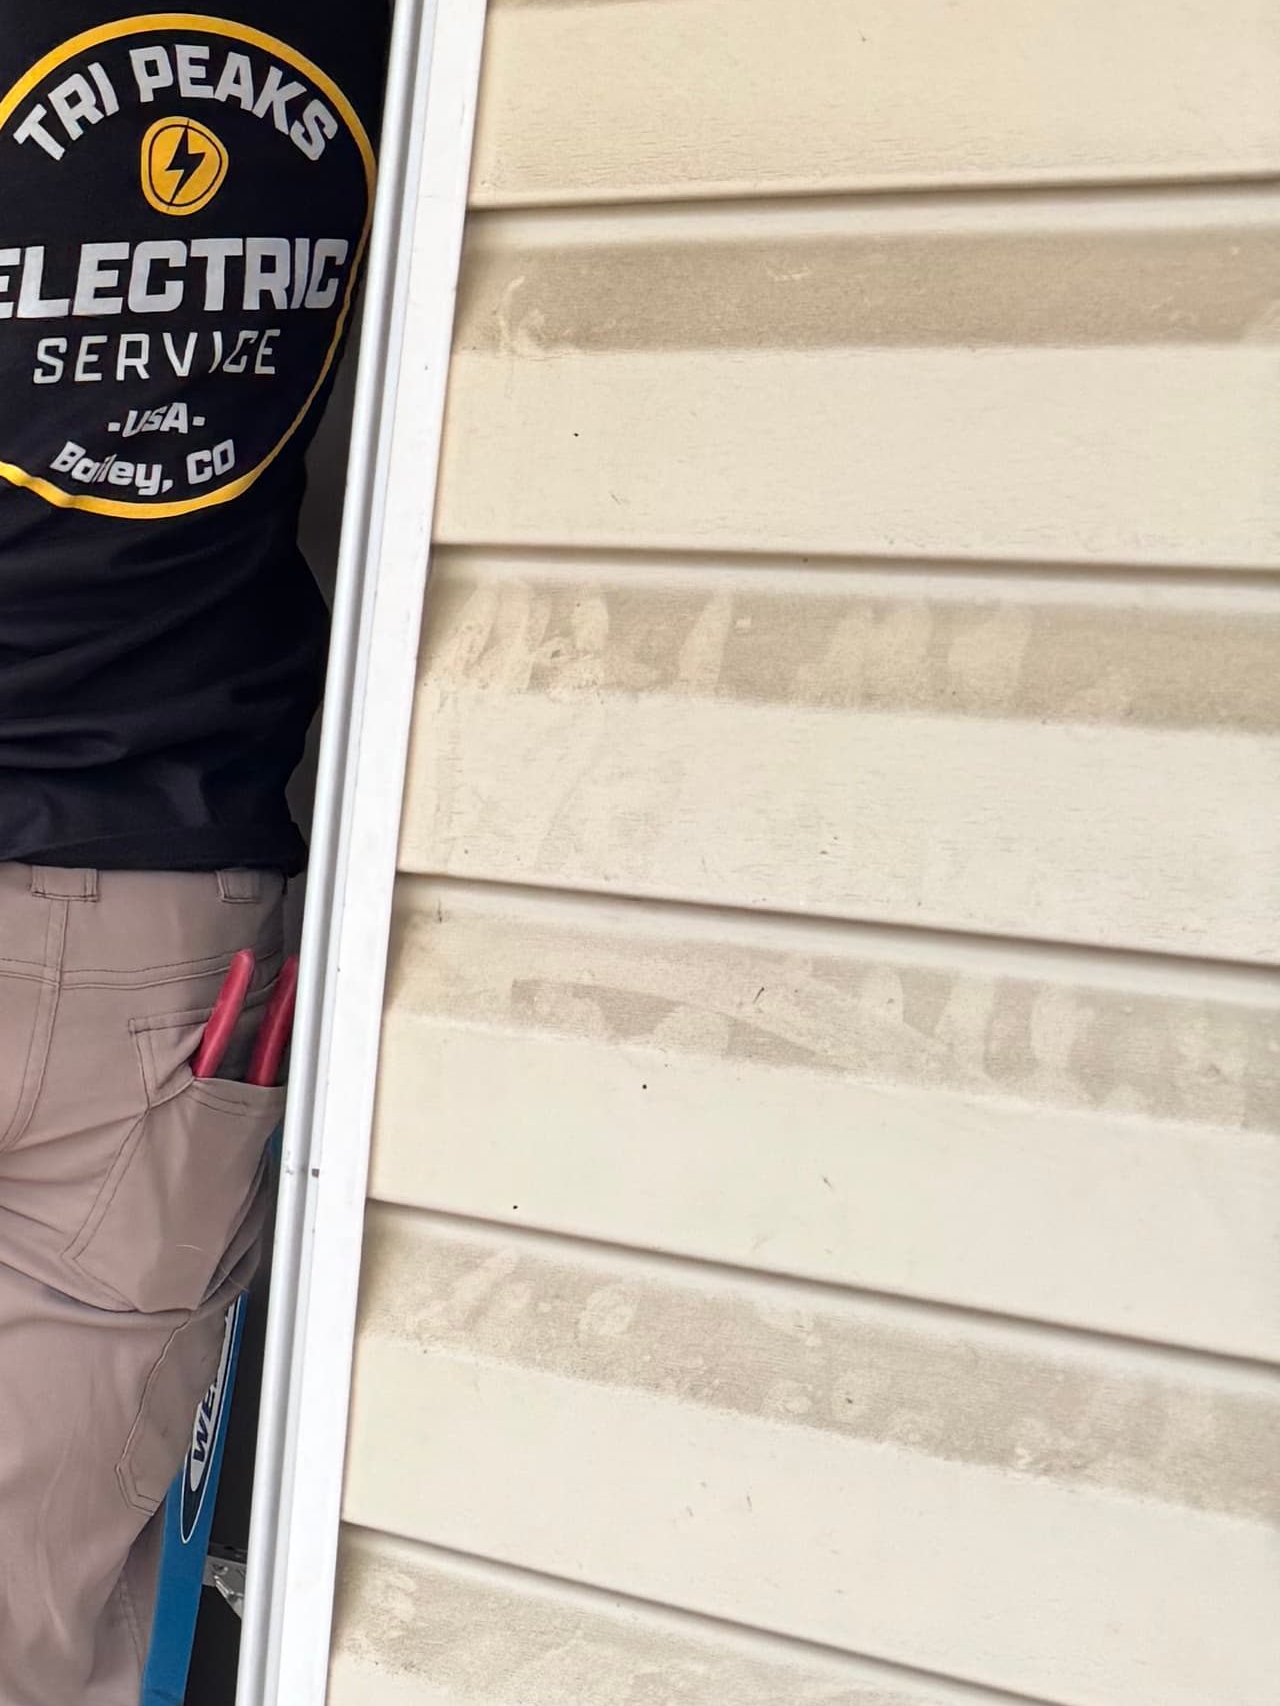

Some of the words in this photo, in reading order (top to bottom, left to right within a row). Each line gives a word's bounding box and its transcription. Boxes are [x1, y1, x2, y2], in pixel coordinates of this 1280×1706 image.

[13, 62, 120, 161] TRI
[129, 43, 338, 161] PEAKS
[32, 328, 282, 385] SERVICE
[49, 440, 174, 497] Bailey,
[185, 439, 237, 485] CO
